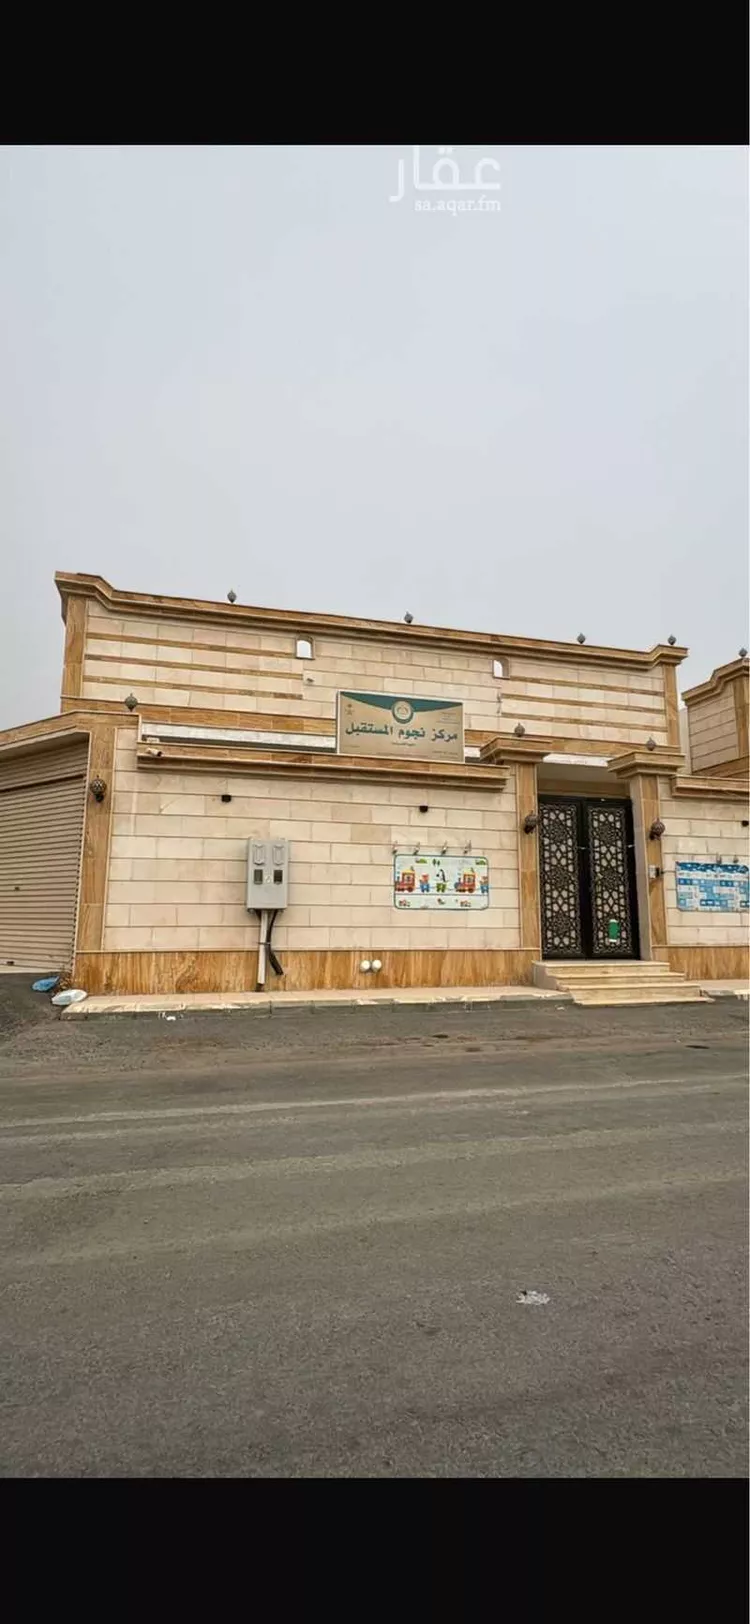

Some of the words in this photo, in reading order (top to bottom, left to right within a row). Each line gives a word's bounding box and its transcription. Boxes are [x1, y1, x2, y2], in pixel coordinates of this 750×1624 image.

[345, 722, 393, 736] المستقبل
[398, 727, 426, 740] نجوم
[431, 728, 458, 742] مركز
